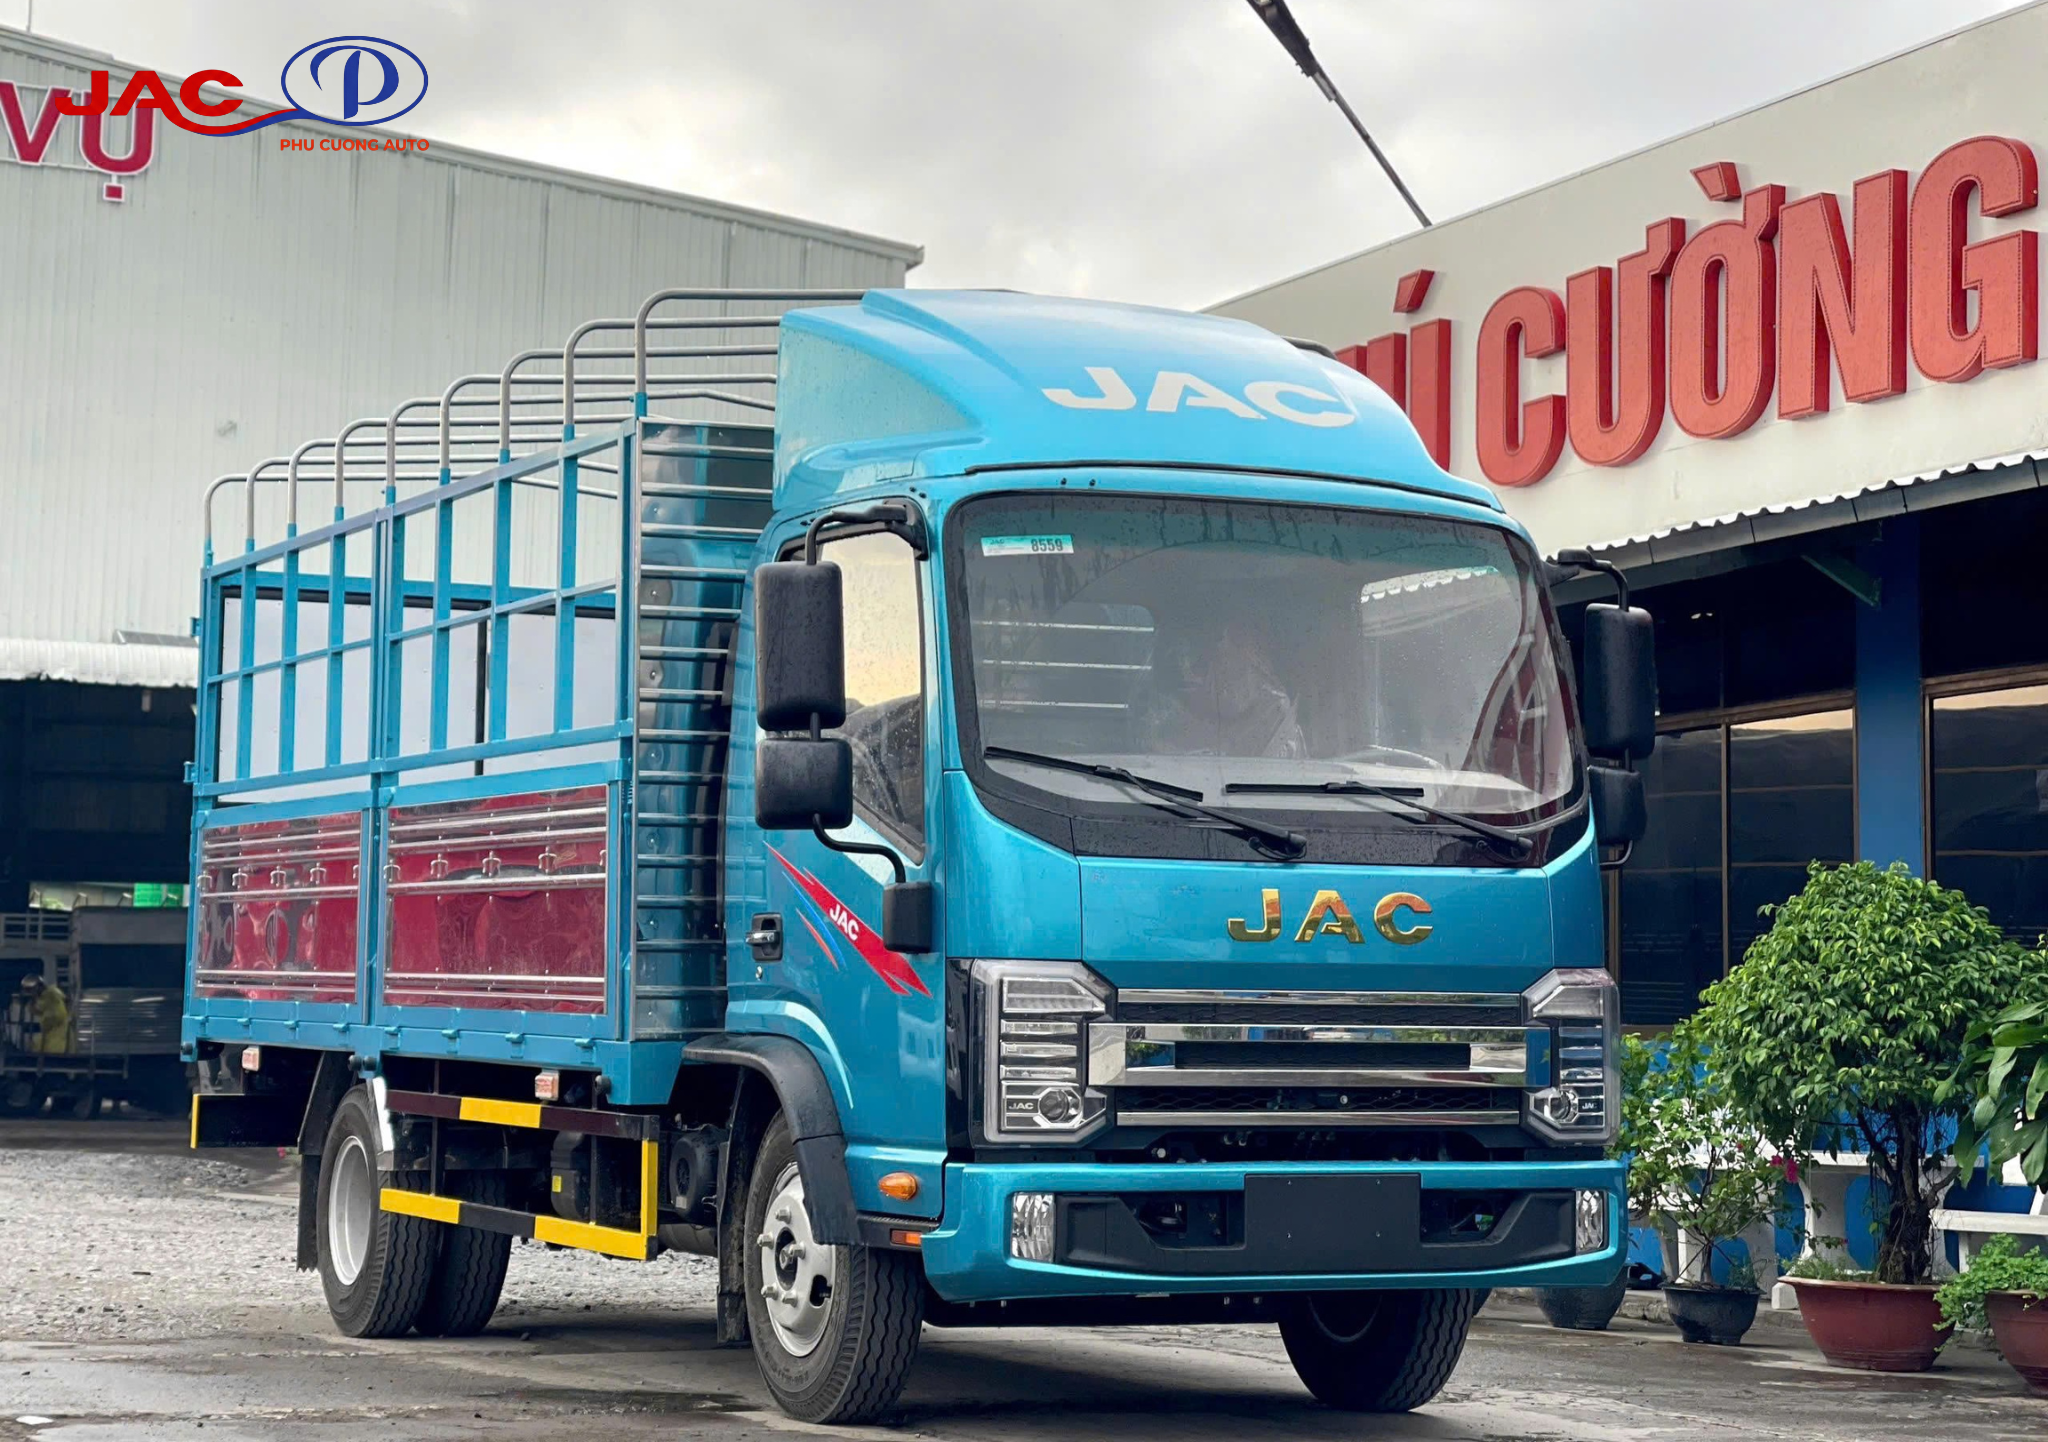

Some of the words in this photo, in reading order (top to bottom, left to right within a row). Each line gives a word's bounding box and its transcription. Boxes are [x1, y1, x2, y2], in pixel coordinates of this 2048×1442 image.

[1476, 134, 2039, 487] CƯỜNG
[1041, 366, 1355, 428] JAC
[1031, 538, 1064, 552] 8559
[829, 903, 859, 941] JAC
[1228, 888, 1434, 945] JAC
[1008, 1102, 1034, 1110] JAC
